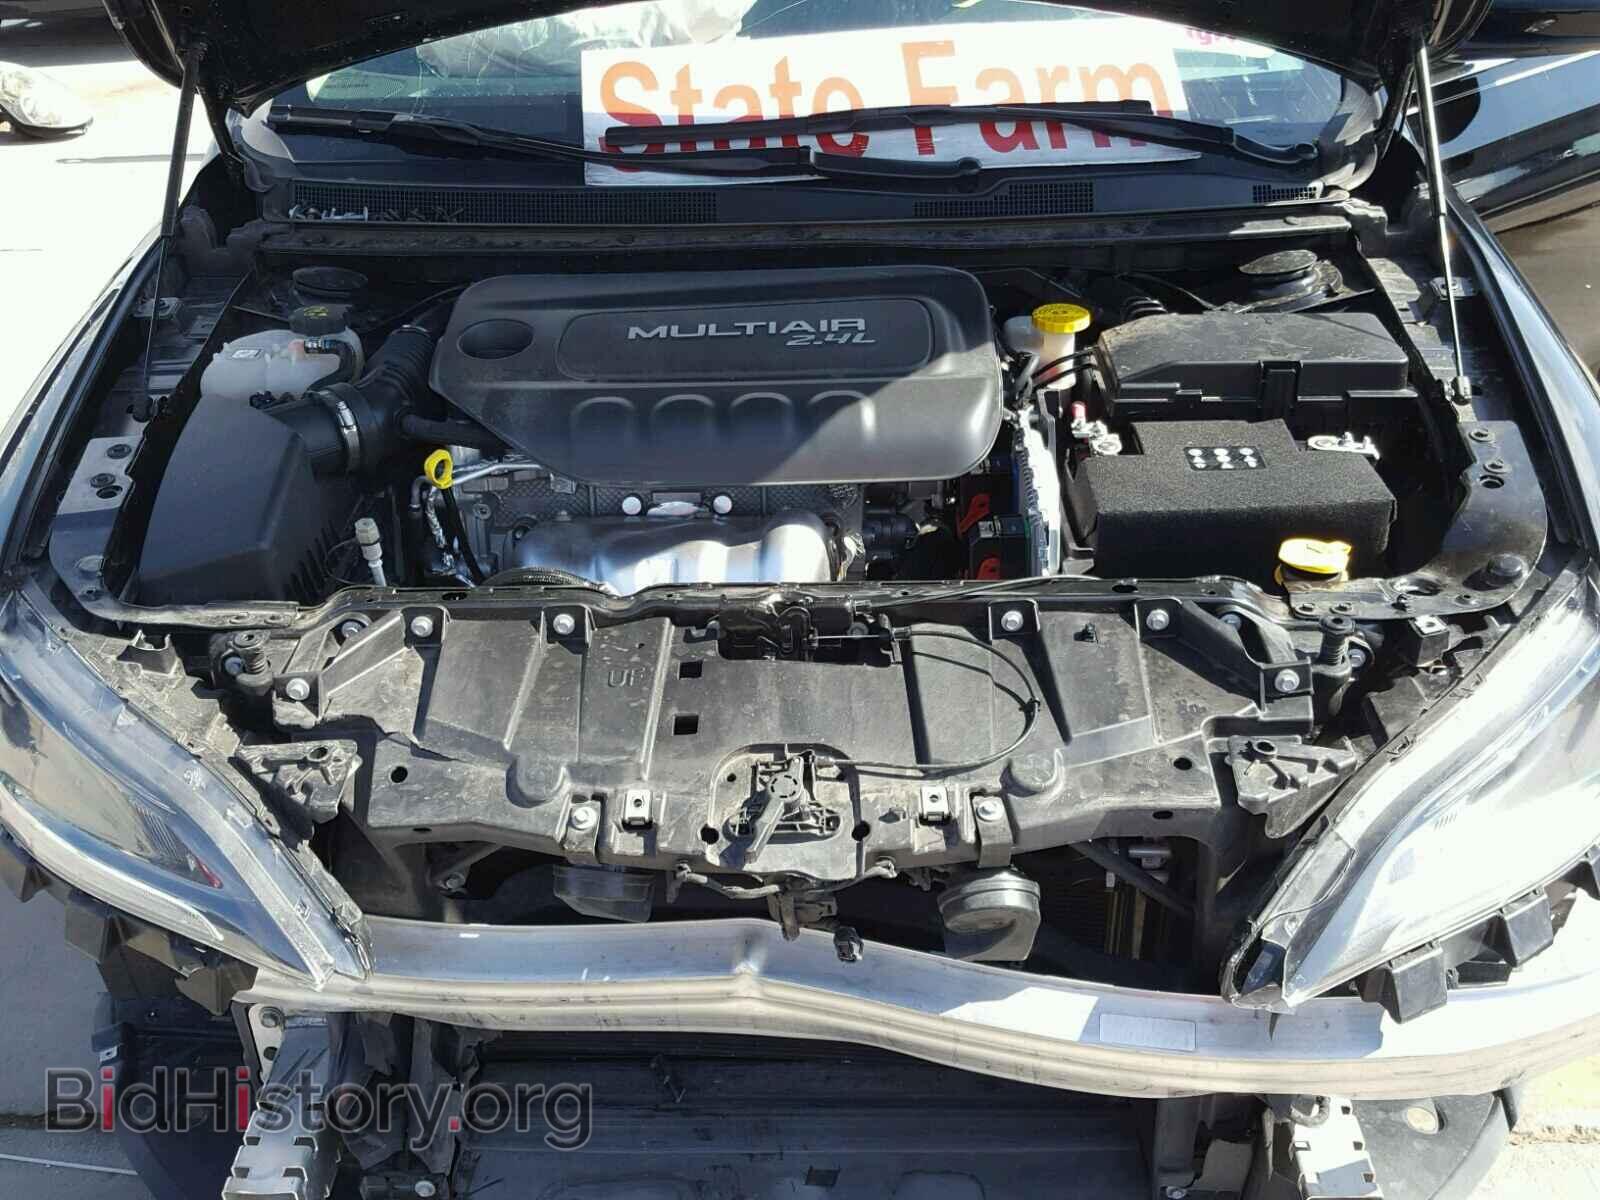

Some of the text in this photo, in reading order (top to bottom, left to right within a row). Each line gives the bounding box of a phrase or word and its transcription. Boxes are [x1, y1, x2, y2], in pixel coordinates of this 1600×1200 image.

[599, 40, 1174, 173] State Farm
[628, 318, 866, 340] MULTIAIR
[786, 332, 876, 347] 2.4L
